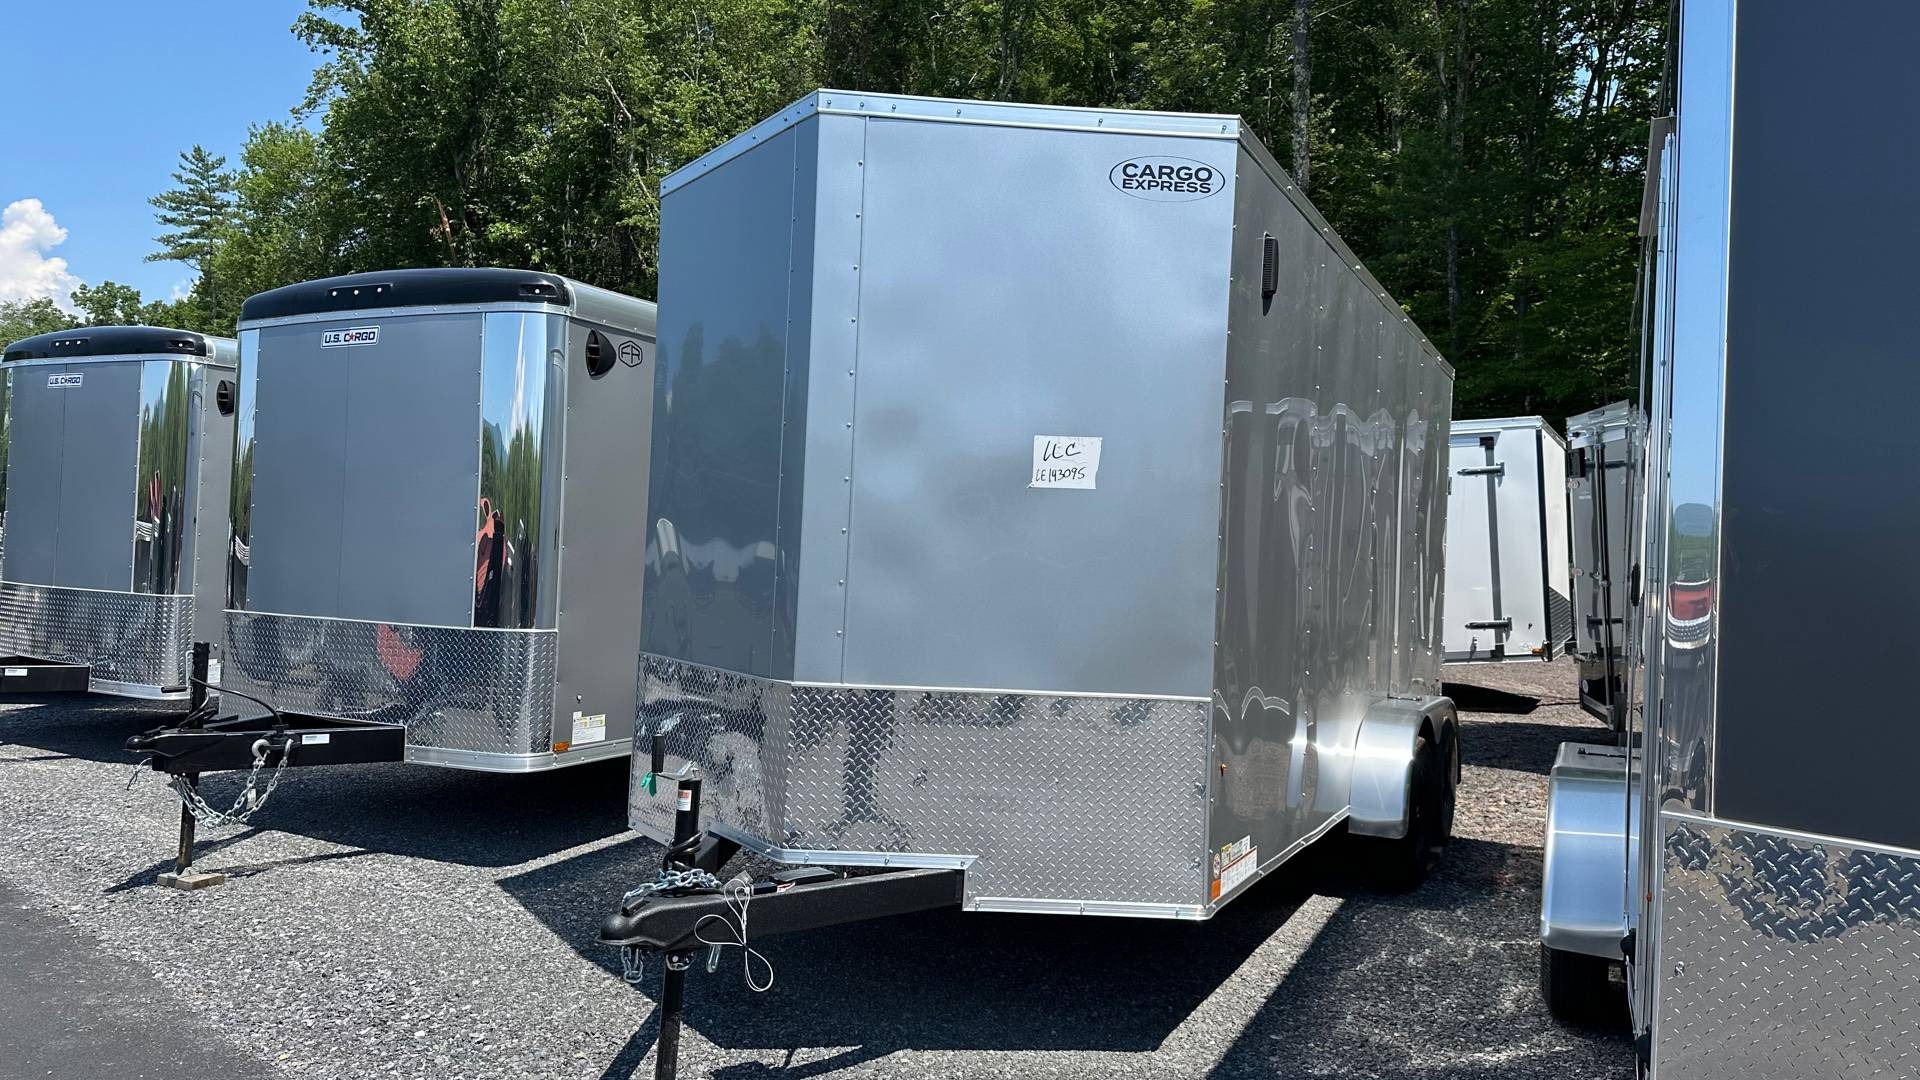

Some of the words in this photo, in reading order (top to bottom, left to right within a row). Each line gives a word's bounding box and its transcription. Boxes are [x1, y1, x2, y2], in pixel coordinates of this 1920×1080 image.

[1122, 163, 1213, 182] CARGO
[1122, 178, 1212, 194] EXPRESS
[324, 333, 342, 344] U.S.
